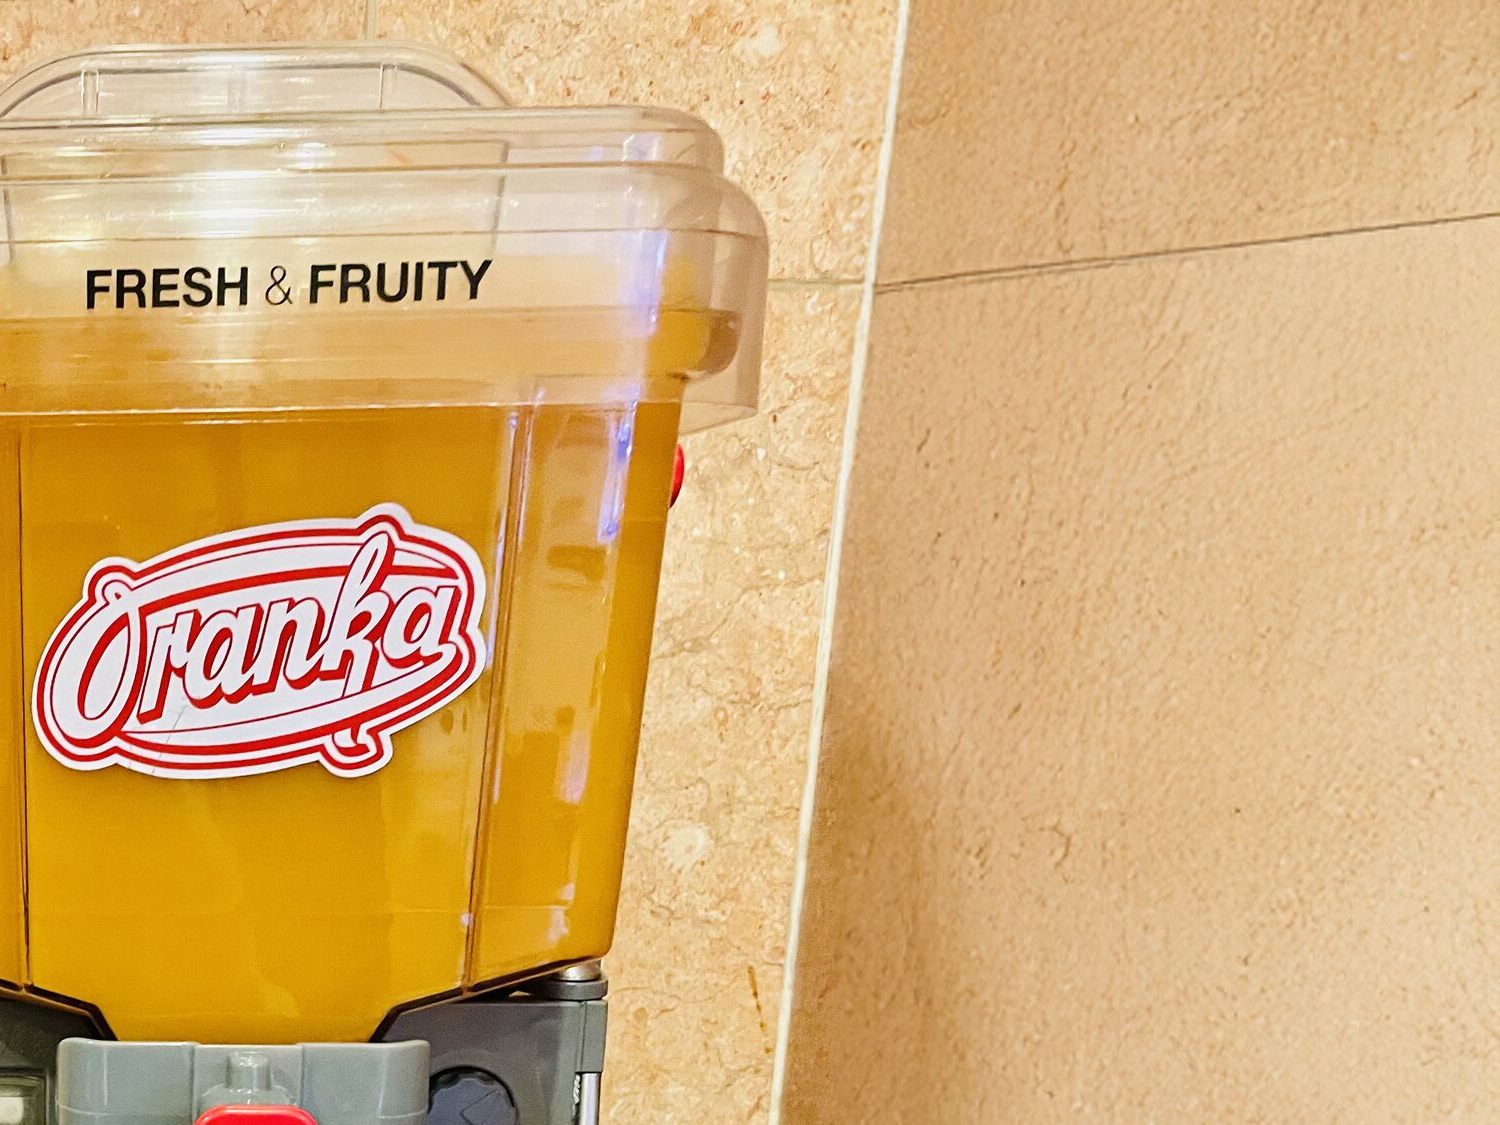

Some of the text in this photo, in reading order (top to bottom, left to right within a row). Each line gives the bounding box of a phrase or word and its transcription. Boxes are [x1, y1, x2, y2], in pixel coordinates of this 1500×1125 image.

[86, 258, 493, 310] FRESH & FRUITY
[48, 530, 466, 748] Oranka
